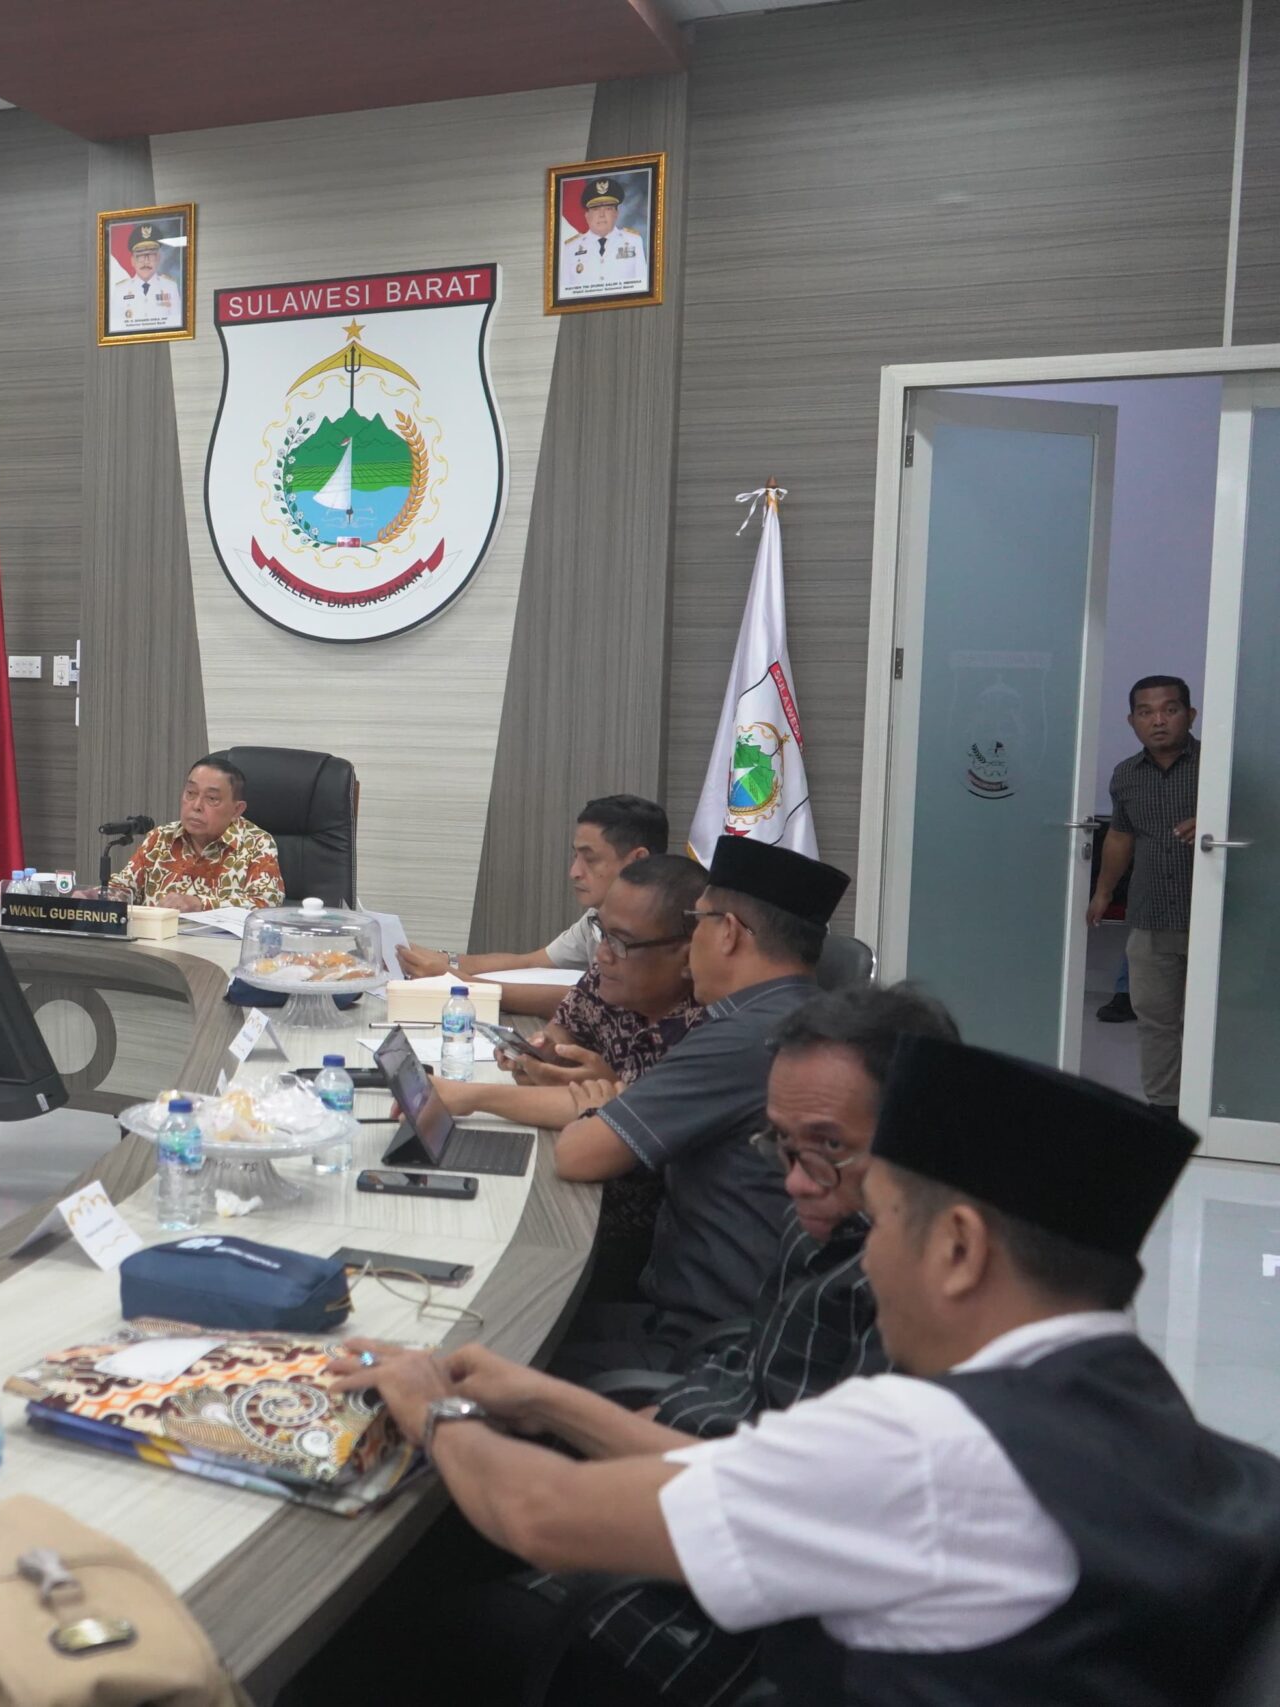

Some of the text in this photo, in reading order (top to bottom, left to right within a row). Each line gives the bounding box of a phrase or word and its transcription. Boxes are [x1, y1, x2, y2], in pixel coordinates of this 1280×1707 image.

[228, 274, 481, 318] SULAWESI BARAT
[269, 568, 423, 609] MELLETE DIATONGANAN
[9, 904, 118, 924] WAKIL GUBERNUR
